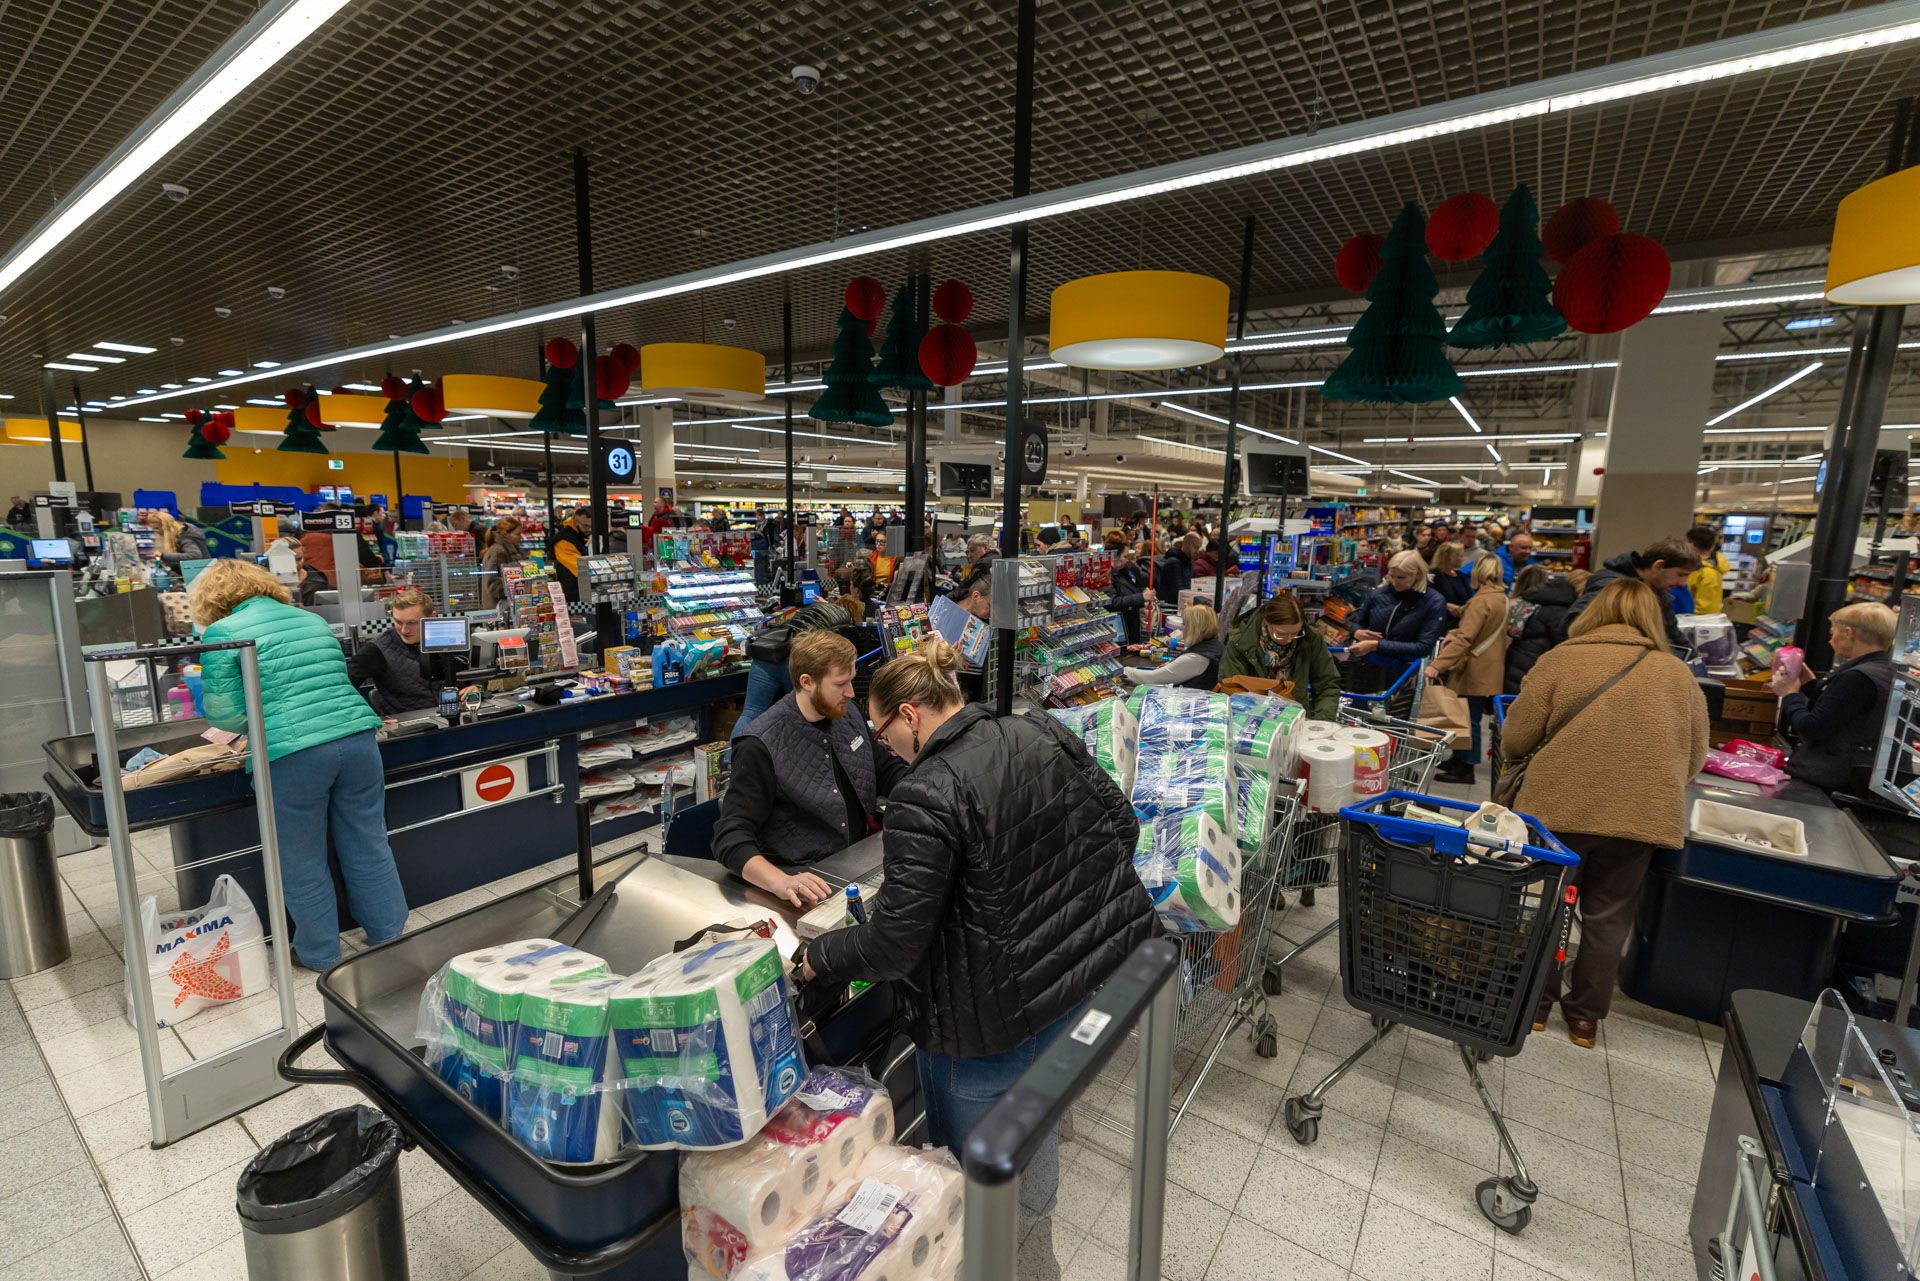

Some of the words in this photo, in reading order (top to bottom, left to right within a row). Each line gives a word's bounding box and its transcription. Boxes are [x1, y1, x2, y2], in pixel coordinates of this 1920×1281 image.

[612, 454, 628, 470] 31
[1027, 441, 1041, 464] 29
[337, 518, 350, 526] 35
[156, 916, 234, 954] MAXIMA
